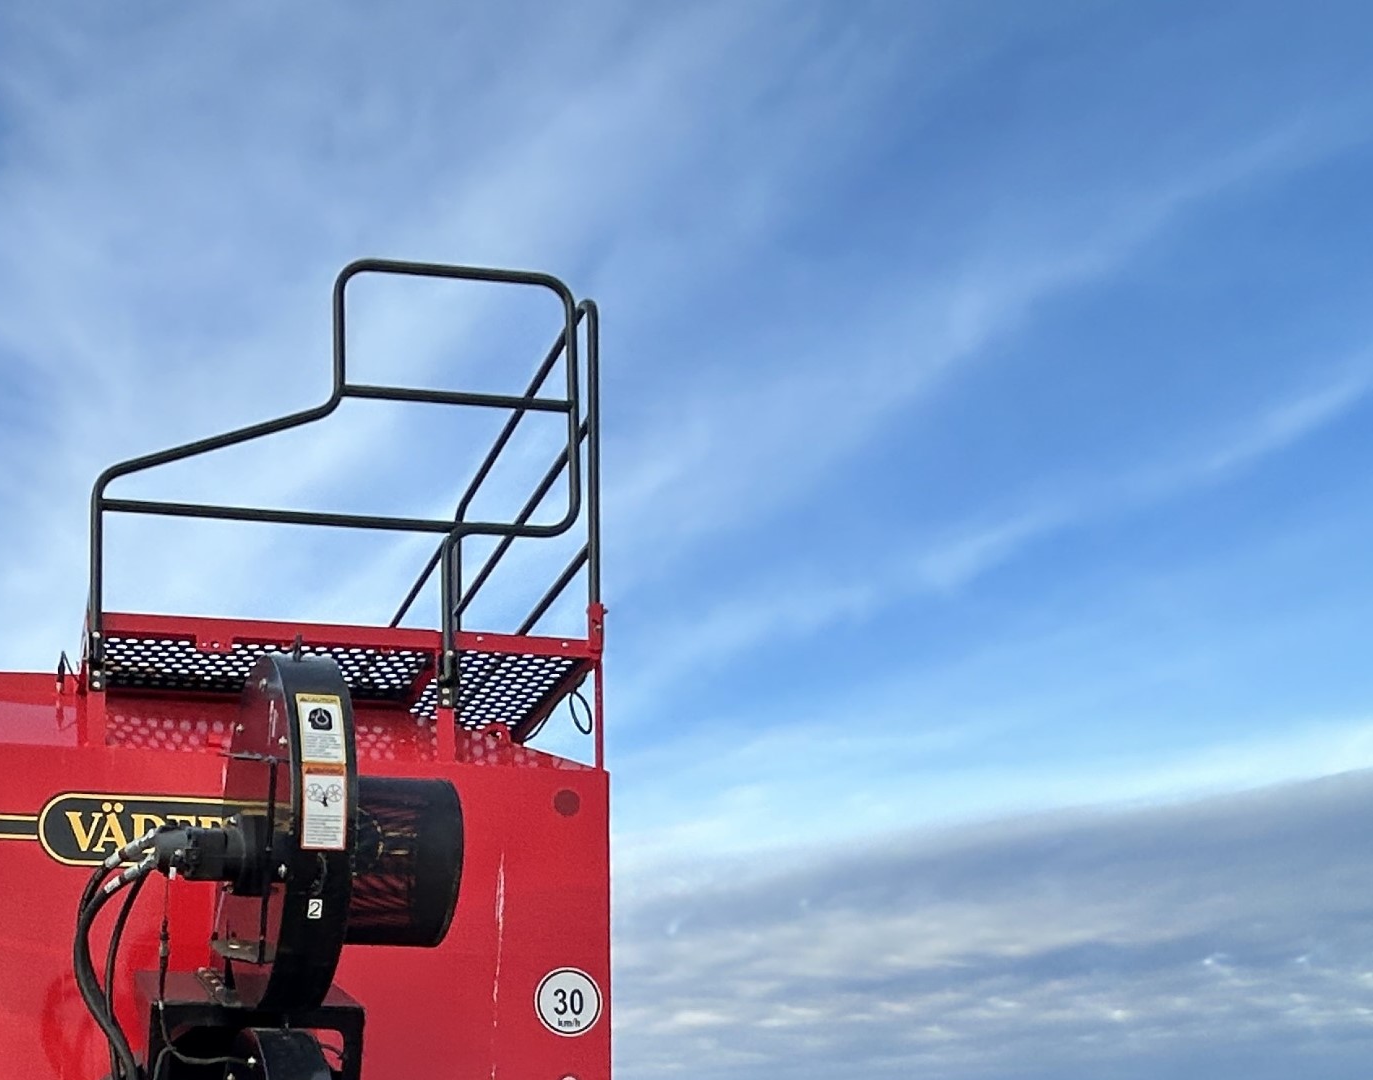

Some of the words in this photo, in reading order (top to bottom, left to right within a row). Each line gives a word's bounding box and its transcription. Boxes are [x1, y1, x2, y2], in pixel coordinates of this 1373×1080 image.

[309, 901, 320, 917] 2
[554, 988, 584, 1016] 30
[558, 1017, 580, 1028] km/h
